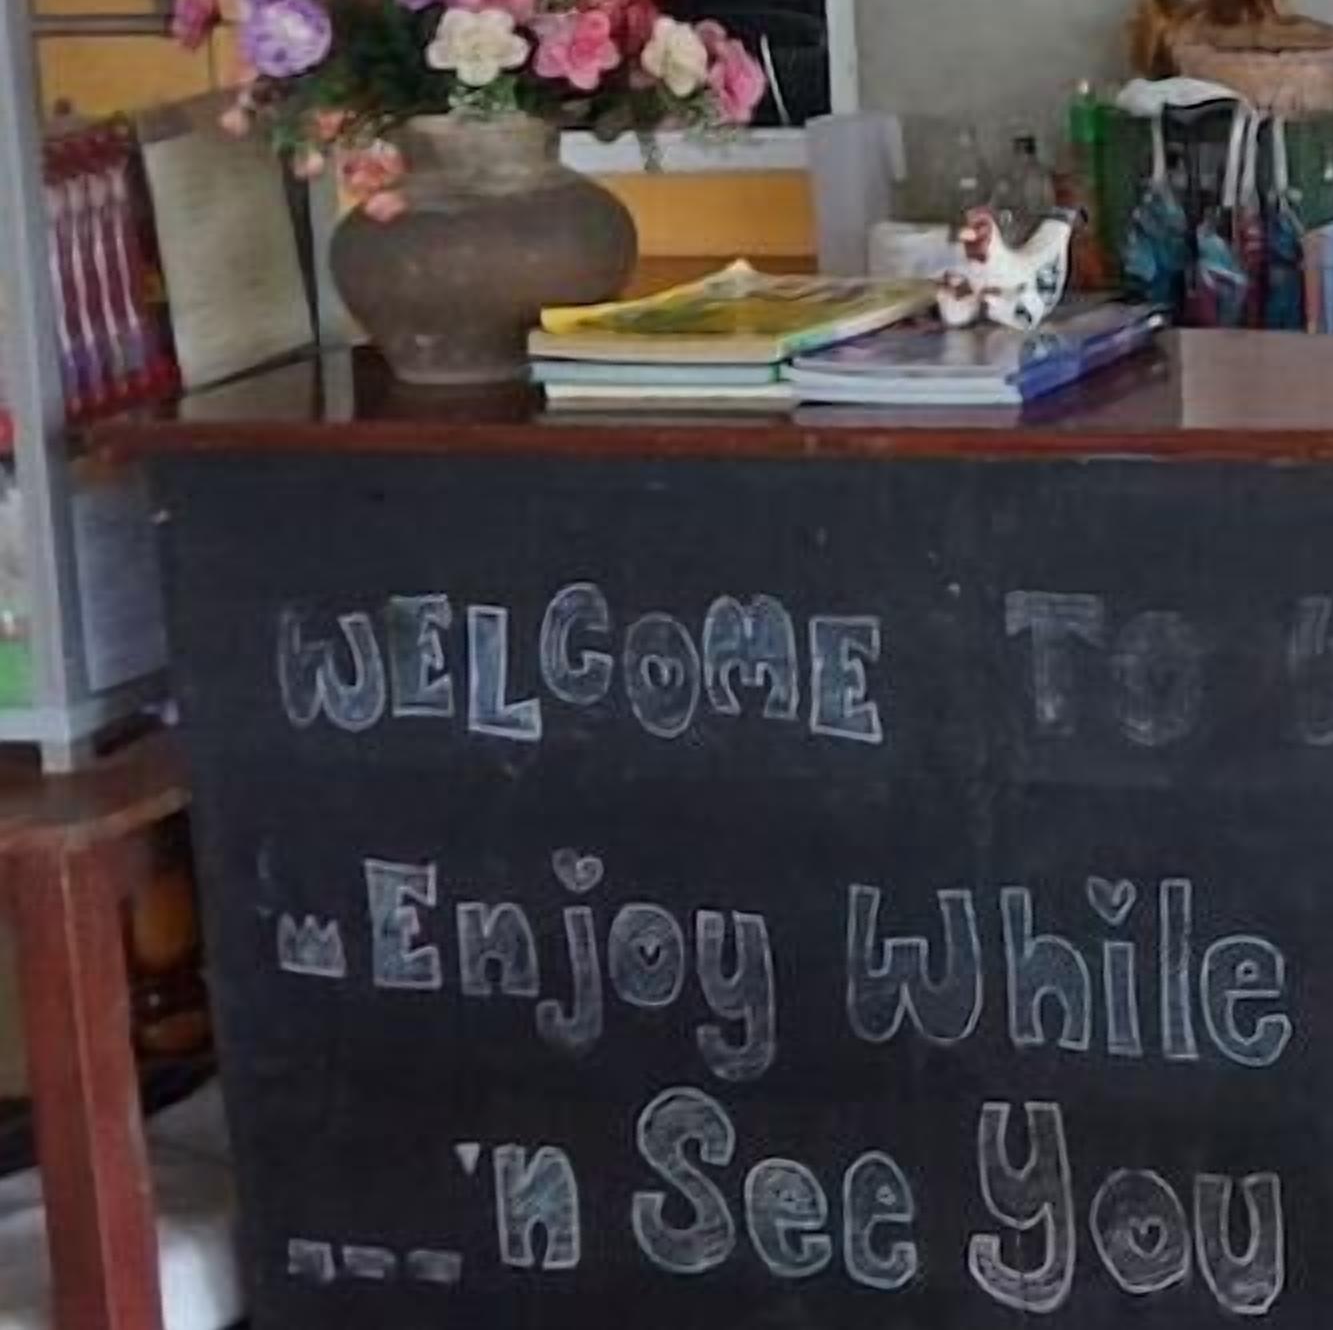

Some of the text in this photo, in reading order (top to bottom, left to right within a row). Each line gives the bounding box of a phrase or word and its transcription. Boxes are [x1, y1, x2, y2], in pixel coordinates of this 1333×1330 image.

[277, 583, 885, 744] WELCOME
[1004, 589, 1197, 748] TO
[363, 848, 778, 1082] Enjoy
[846, 875, 1294, 1069] While
[632, 1087, 920, 1289] See
